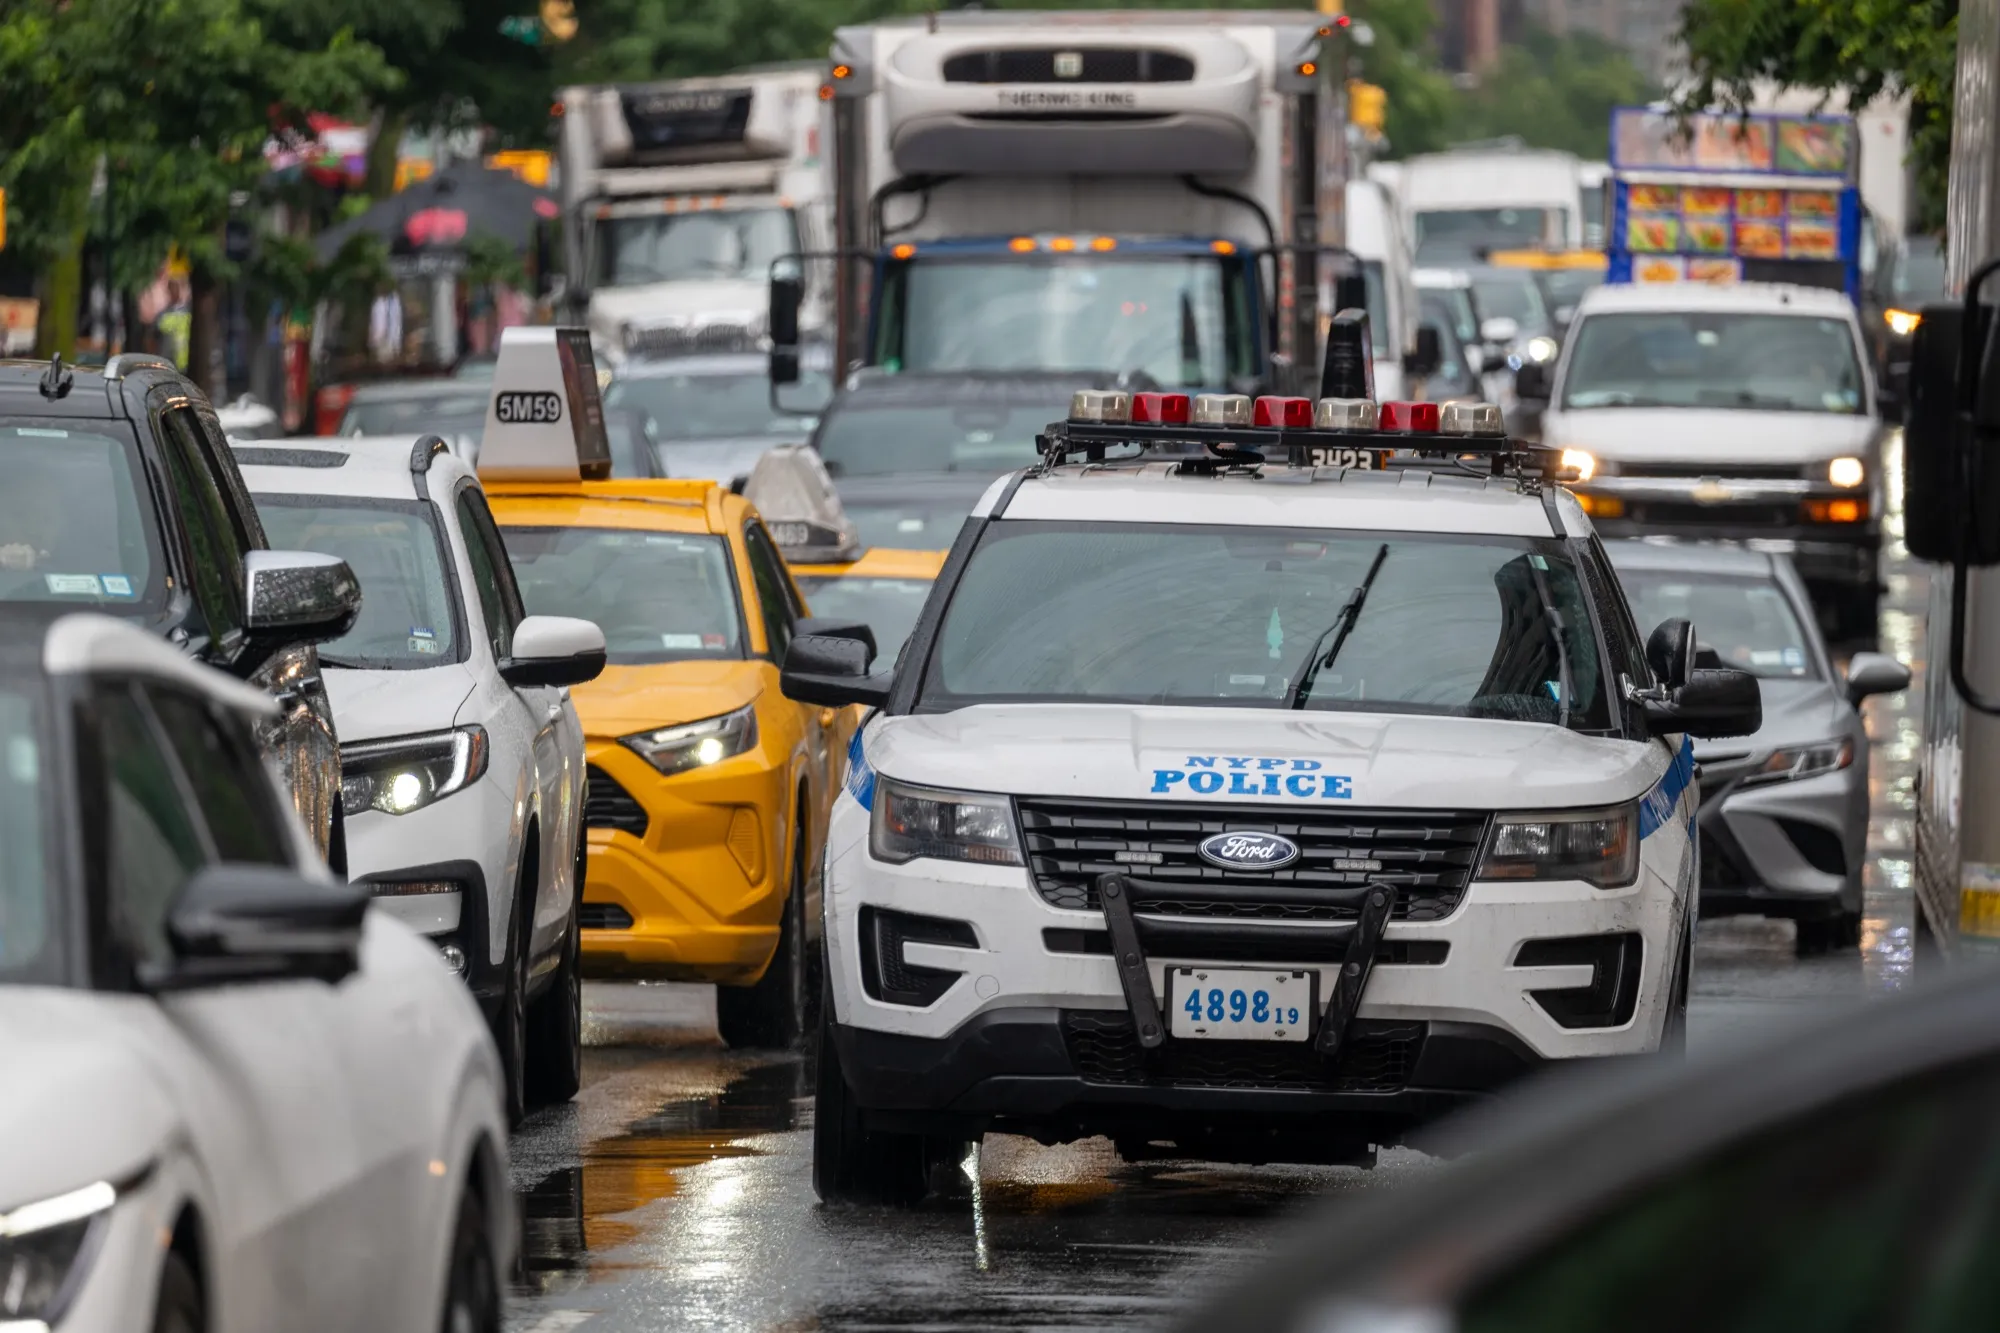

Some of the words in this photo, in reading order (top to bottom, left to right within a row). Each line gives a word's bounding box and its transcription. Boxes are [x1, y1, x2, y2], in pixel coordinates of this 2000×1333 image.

[499, 395, 560, 421] 5M59
[1184, 756, 1323, 771] NYPD
[1150, 770, 1352, 800] POLICE
[1221, 836, 1276, 859] Ford
[1184, 988, 1270, 1023] 4898
[1275, 1007, 1299, 1024] 19
